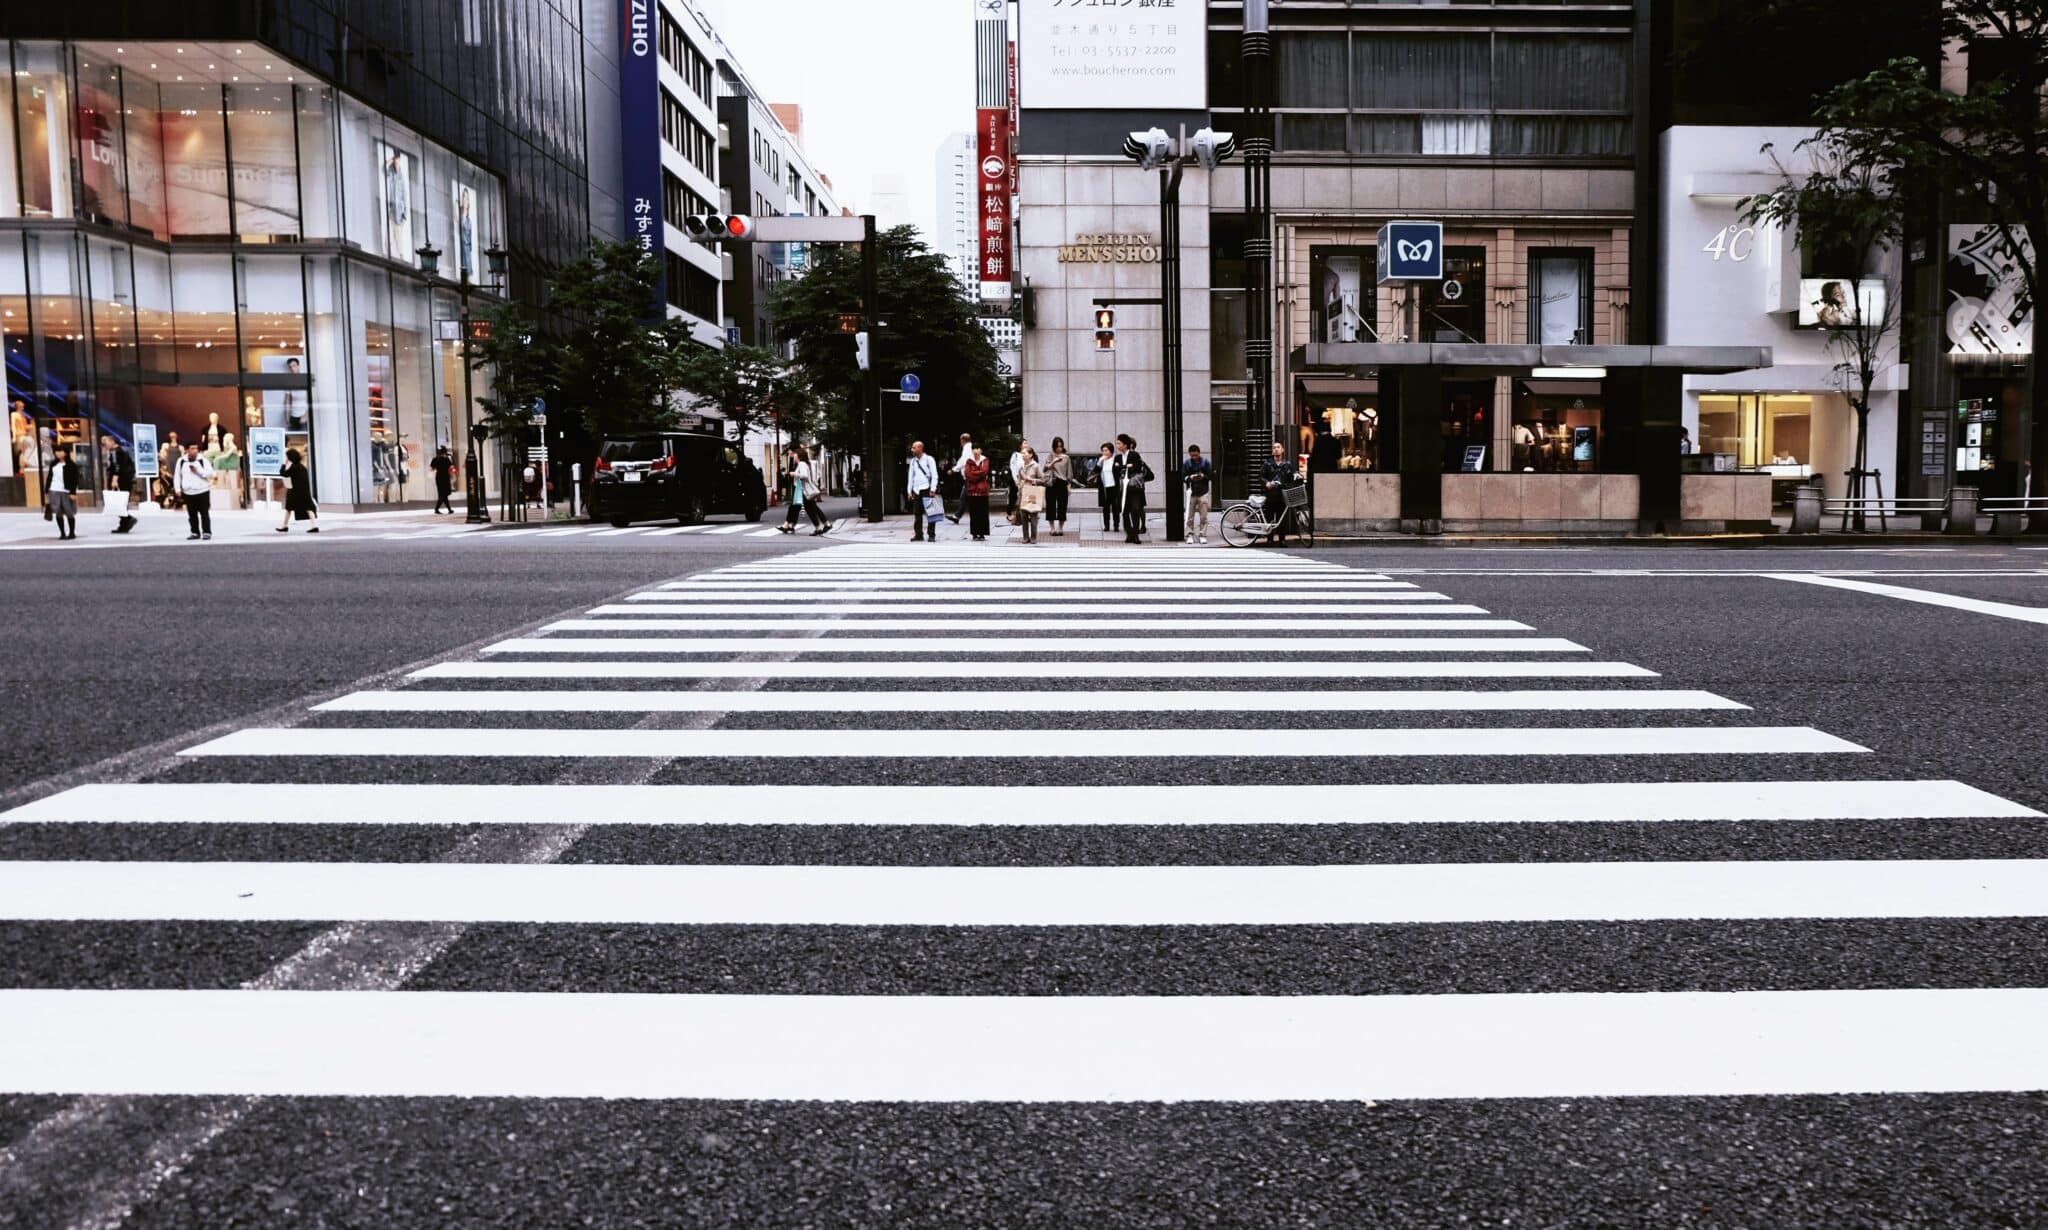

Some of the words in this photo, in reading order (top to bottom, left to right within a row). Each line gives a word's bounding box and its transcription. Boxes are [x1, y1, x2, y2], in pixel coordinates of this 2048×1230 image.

[1076, 233, 1152, 246] TEIJIN
[1059, 246, 1113, 263] MEN'S
[998, 364, 1012, 375] 22
